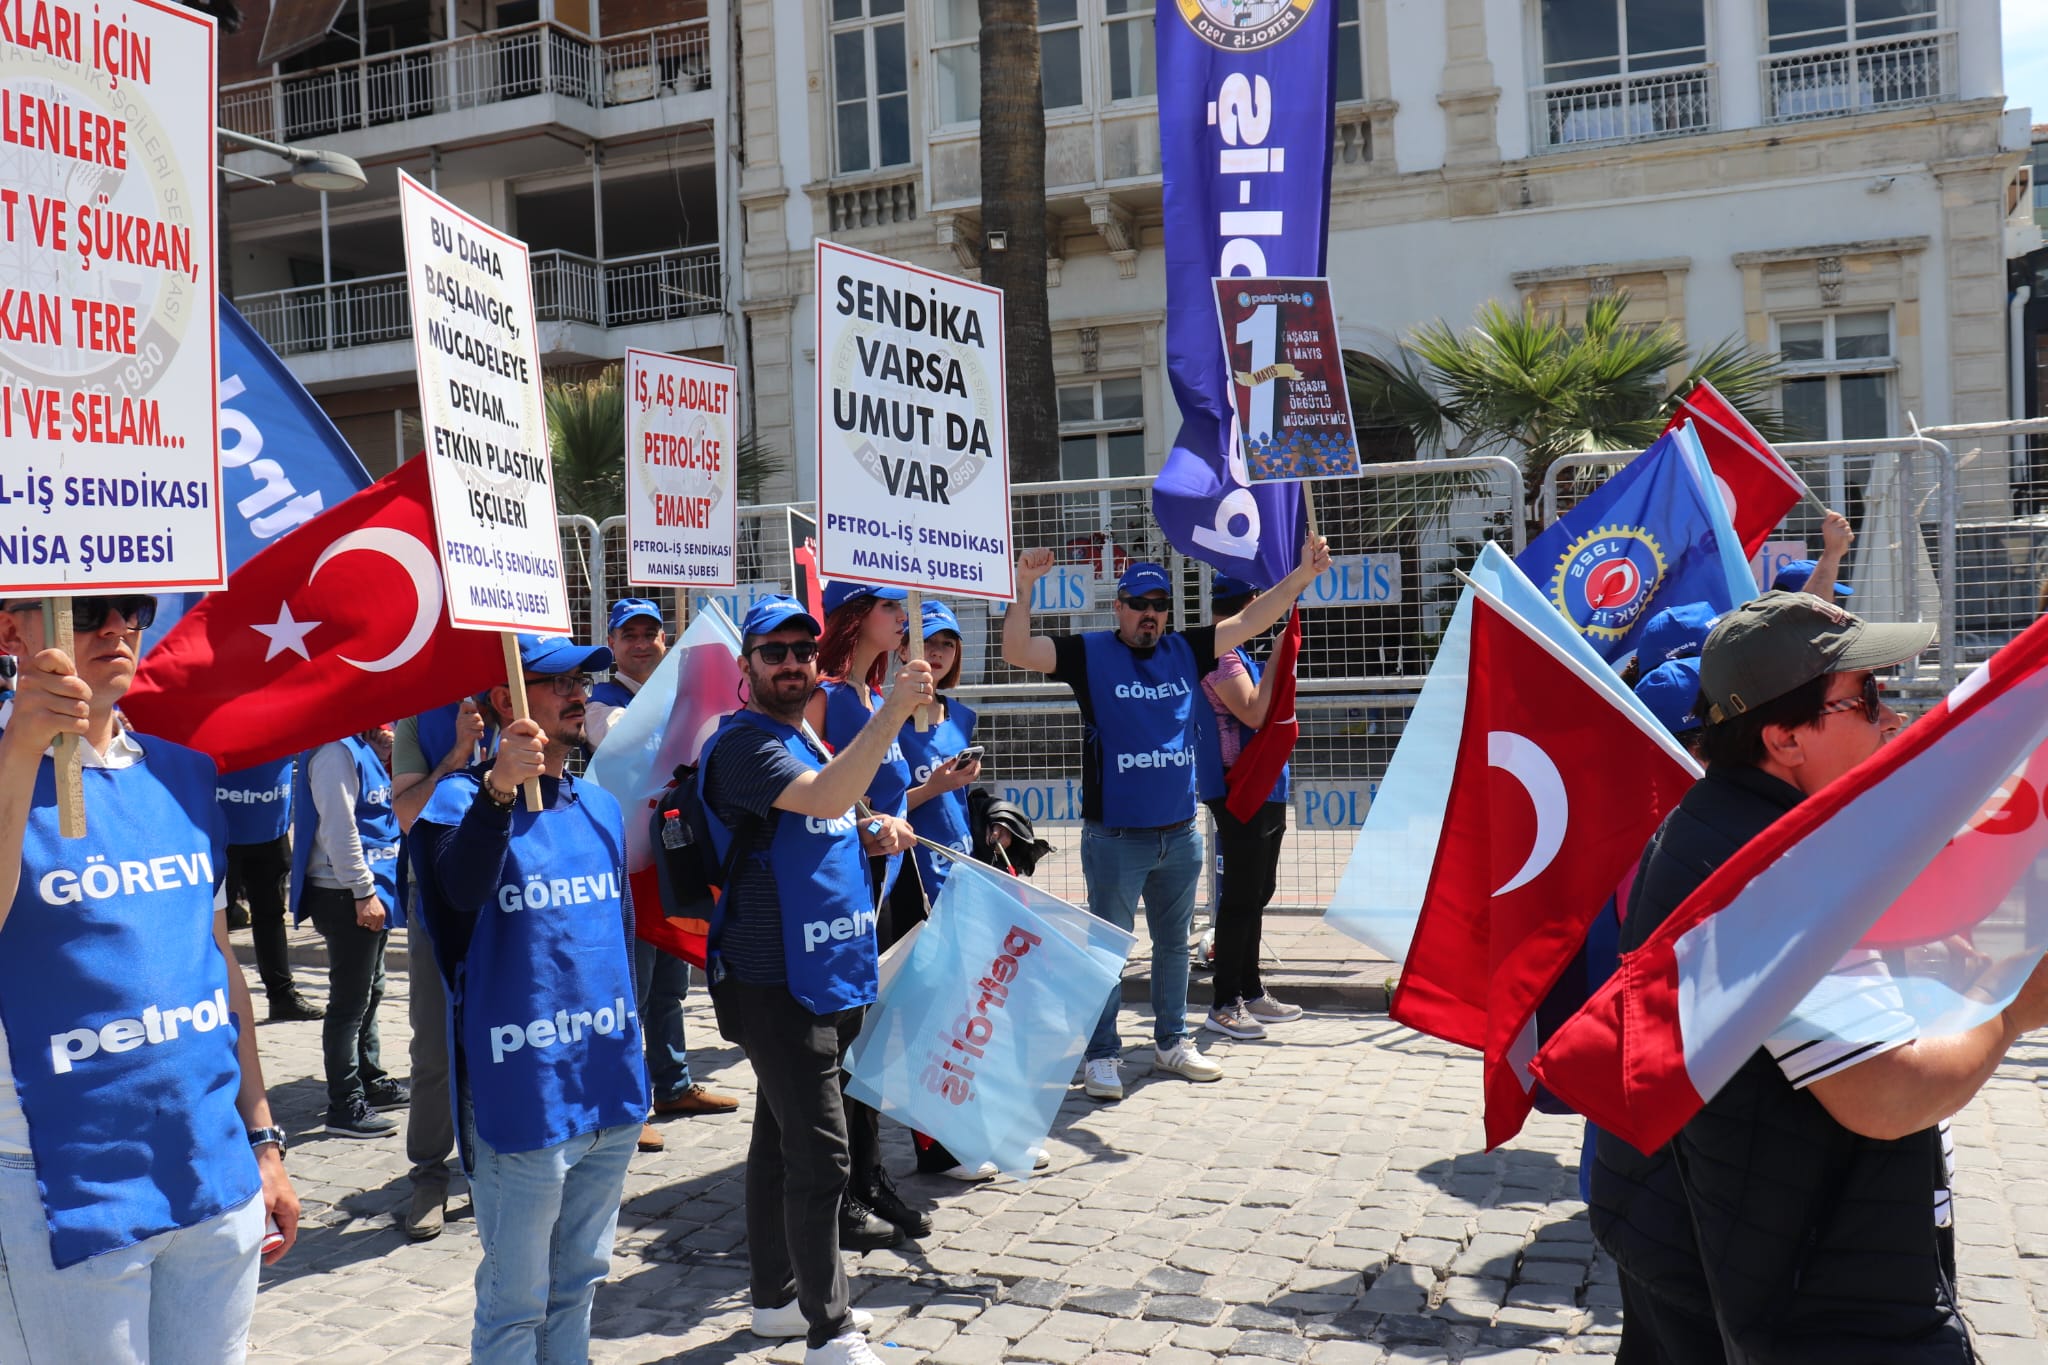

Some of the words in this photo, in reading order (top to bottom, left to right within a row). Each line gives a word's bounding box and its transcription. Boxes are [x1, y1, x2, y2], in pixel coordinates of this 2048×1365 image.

[94, 3, 151, 90] İÇİN
[2, 88, 127, 171] LENLERE
[28, 194, 67, 252] VE
[77, 193, 199, 285] ŞÜKRAN,
[430, 216, 453, 254] BU
[457, 232, 504, 281] DAHA
[71, 298, 137, 355] TERE
[424, 263, 521, 340] BAŞLANGIÇ,
[836, 274, 985, 349] SENDİKA
[428, 316, 529, 385] MÜCADELEYE
[856, 335, 967, 399] VARSA
[1294, 347, 1323, 360] MAYIS
[449, 379, 520, 429] DEVAM...
[635, 359, 652, 413] İŞ,
[656, 373, 674, 416] AŞ
[678, 377, 728, 415] ADALET
[1287, 379, 1327, 395] YAŞASIN
[21, 388, 62, 440] VE
[71, 392, 185, 449] SELAM...
[833, 387, 934, 445] UMUT
[946, 412, 993, 458] DA
[434, 425, 483, 468] ETKİN
[485, 443, 547, 485] PLASTİK
[644, 431, 720, 480] PETROL-İŞE
[879, 455, 950, 505] VAR
[64, 472, 208, 508] SENDİKASI
[468, 480, 528, 530] İŞÇİLERİ
[655, 493, 711, 529] EMANET
[79, 527, 174, 572] ŞUBESİ
[633, 540, 682, 557] PETROL-İŞ
[684, 539, 732, 557] SENDİKASI
[827, 513, 913, 546] PETROL-İŞ
[918, 528, 1004, 554] SENDİKASI
[446, 540, 505, 575] PETROL-İŞ
[505, 550, 559, 579] SENDİKASI
[648, 561, 686, 576] MANİSA
[688, 562, 719, 580] ŞUBESİ
[853, 549, 922, 574] MANİSA
[927, 559, 983, 581] ŞUBESİ
[1299, 556, 1391, 602] OLİS
[1571, 542, 1620, 578] 1952
[469, 582, 515, 610] MANİSA
[516, 589, 550, 617] ŞUBESİ
